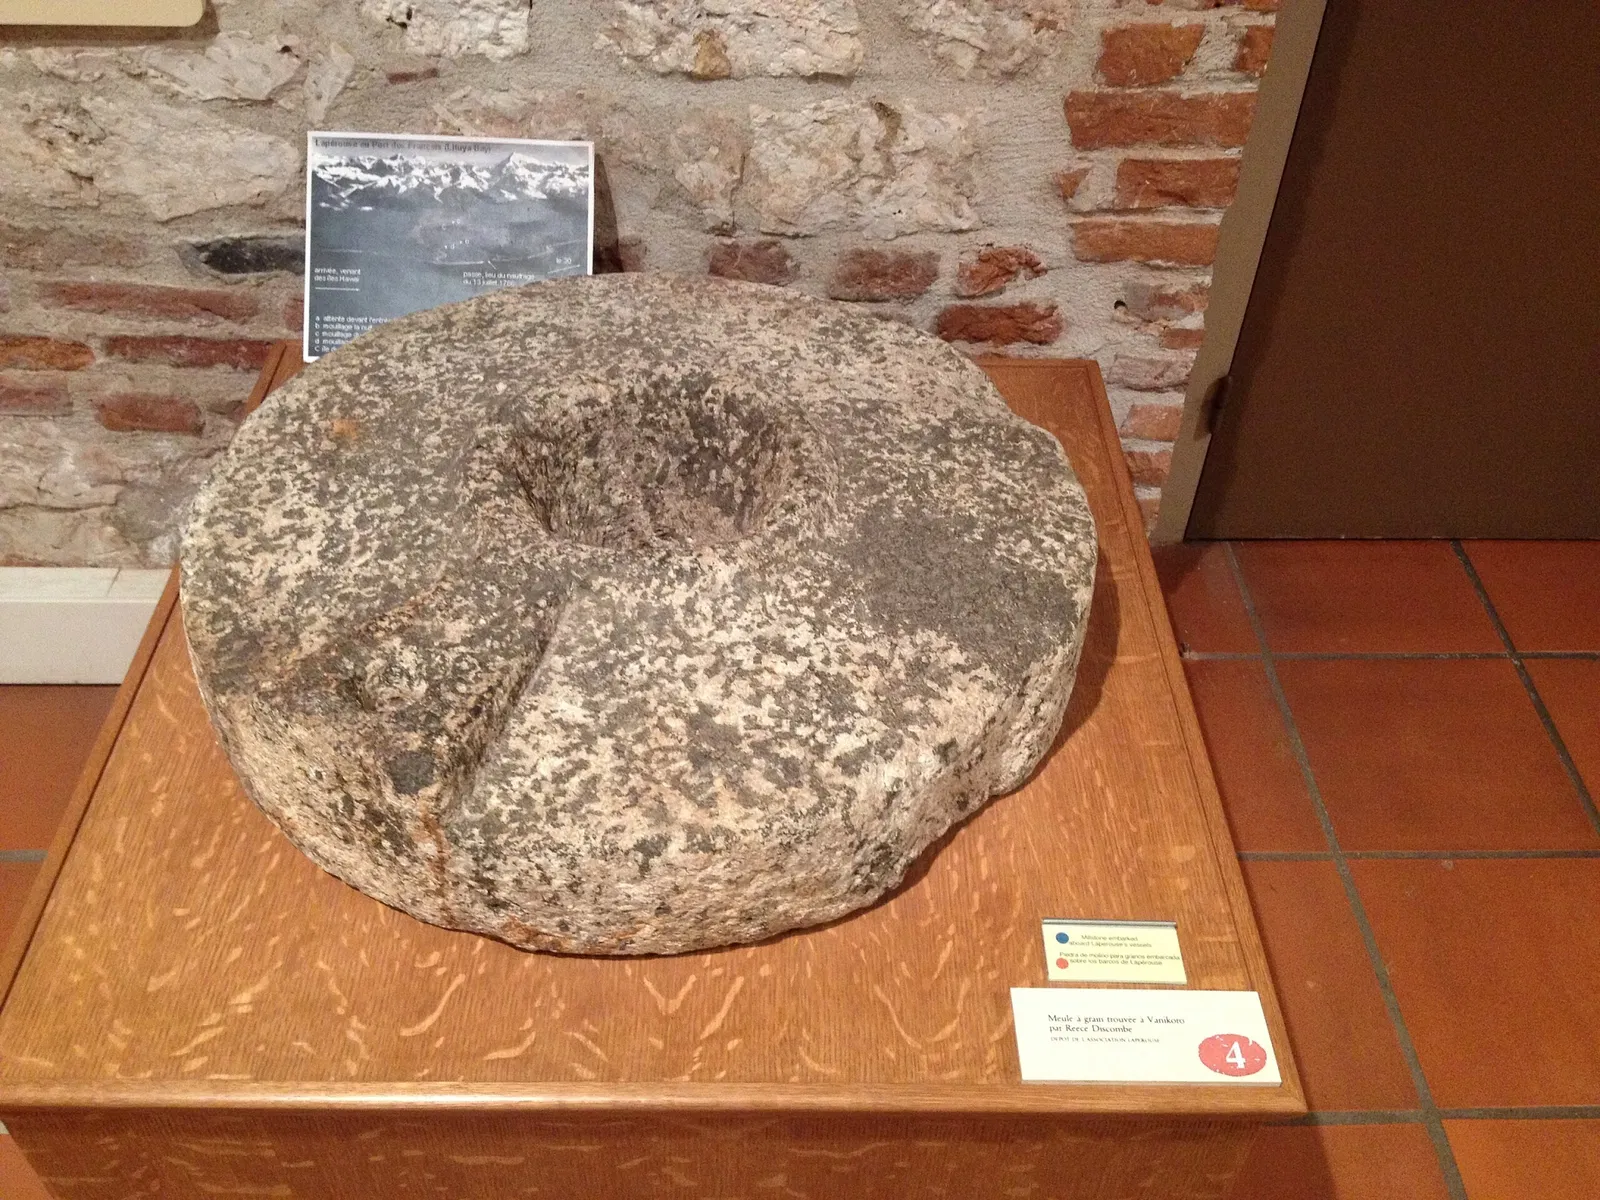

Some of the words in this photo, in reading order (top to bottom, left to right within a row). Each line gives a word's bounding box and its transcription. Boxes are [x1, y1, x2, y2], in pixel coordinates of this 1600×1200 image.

[1084, 1016, 1104, 1026] grain
[1147, 1017, 1185, 1026] Vanikoro
[1049, 1025, 1062, 1034] par
[1225, 1040, 1247, 1069] 4
